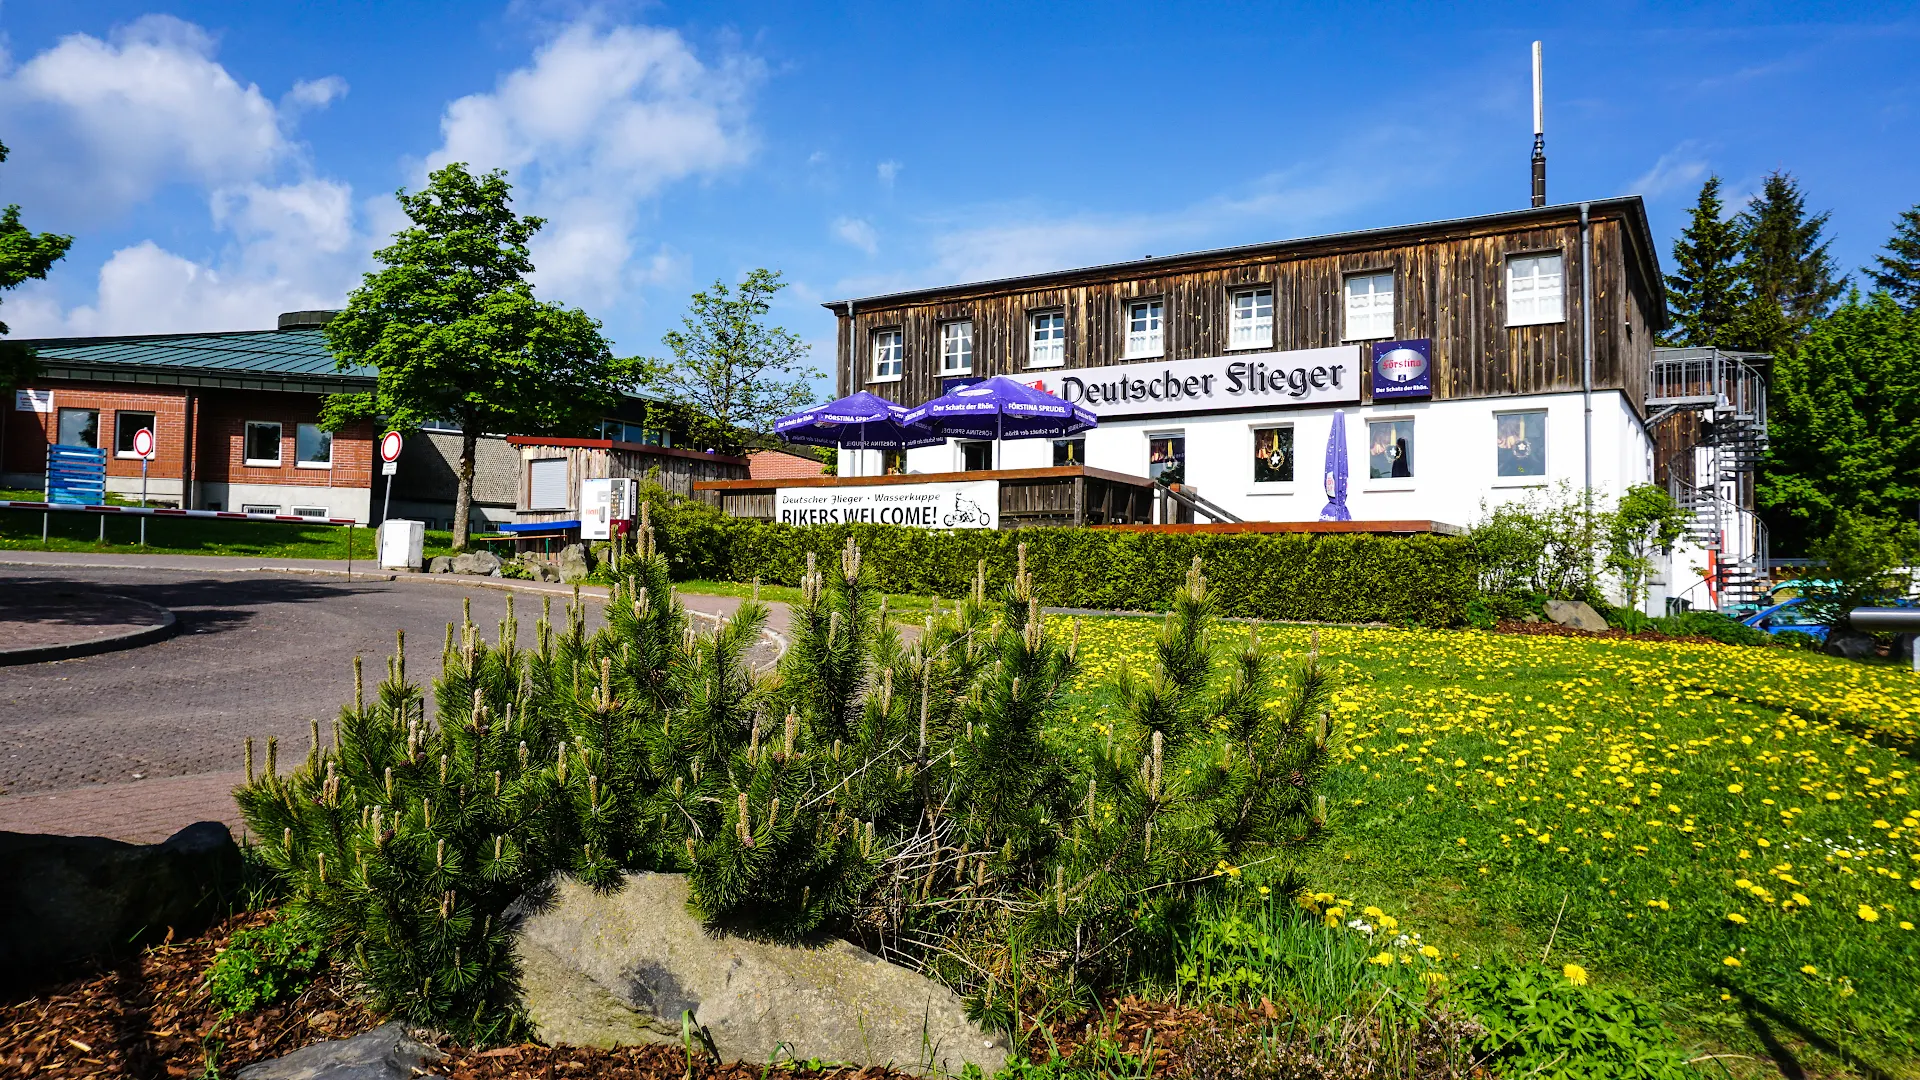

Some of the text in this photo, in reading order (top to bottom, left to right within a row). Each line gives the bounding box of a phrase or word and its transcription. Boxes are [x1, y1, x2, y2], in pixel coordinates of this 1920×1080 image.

[1061, 361, 1343, 405] Deutscher Flieger
[1386, 385, 1403, 393] Schatz
[945, 403, 965, 411] Schatz
[977, 402, 995, 410] Rhön.
[1008, 402, 1066, 413] FÖRSTINA SPRUDEL
[824, 414, 855, 422] FÖRSTINA
[782, 492, 941, 505] Deutscher Flieger Wasserkuppe
[782, 506, 937, 526] BIKERS WELCOME!
